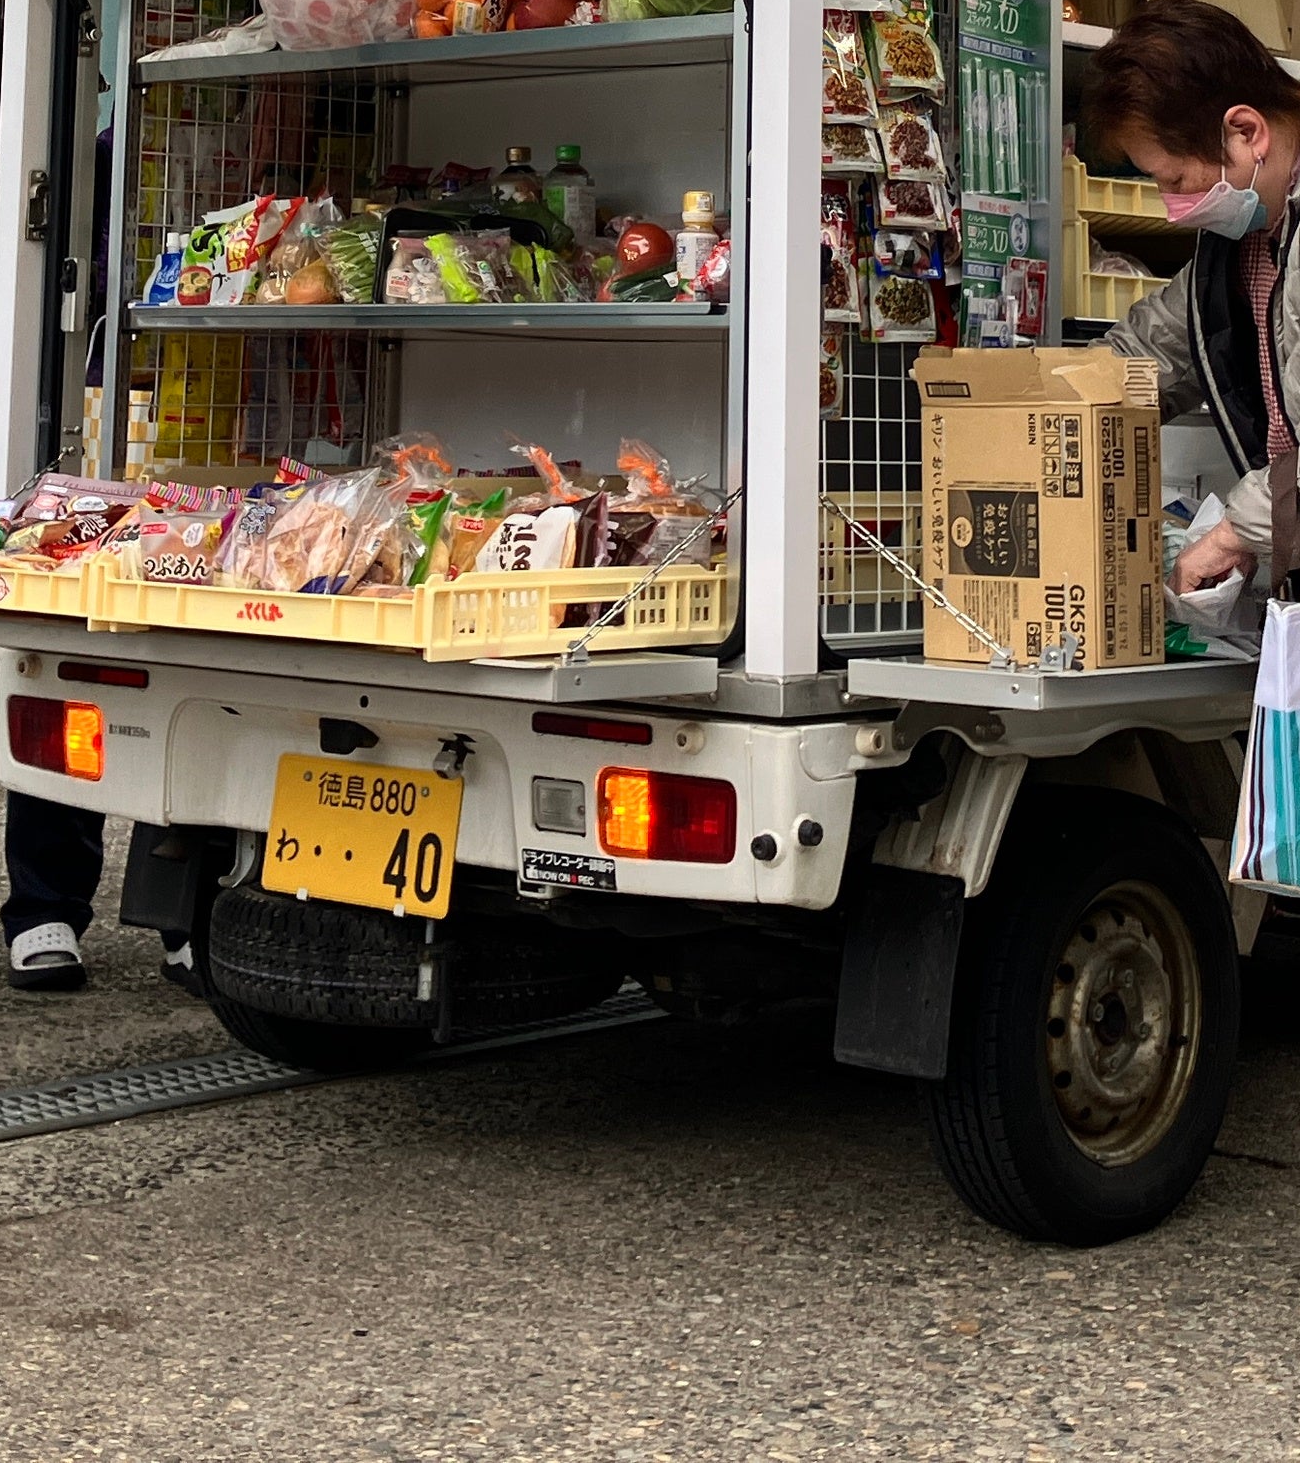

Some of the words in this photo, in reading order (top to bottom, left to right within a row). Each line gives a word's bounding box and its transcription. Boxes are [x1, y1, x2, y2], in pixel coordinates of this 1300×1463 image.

[931, 413, 943, 447] キリン
[1028, 413, 1037, 446] KIRIN
[1102, 416, 1111, 479] GK520
[931, 457, 944, 571] おいしい免疫ケア
[983, 503, 996, 565] 免疫ケア
[997, 503, 1009, 565] おいしい
[144, 556, 209, 577] つぶあん
[275, 828, 299, 862] わ
[383, 828, 443, 903] 40
